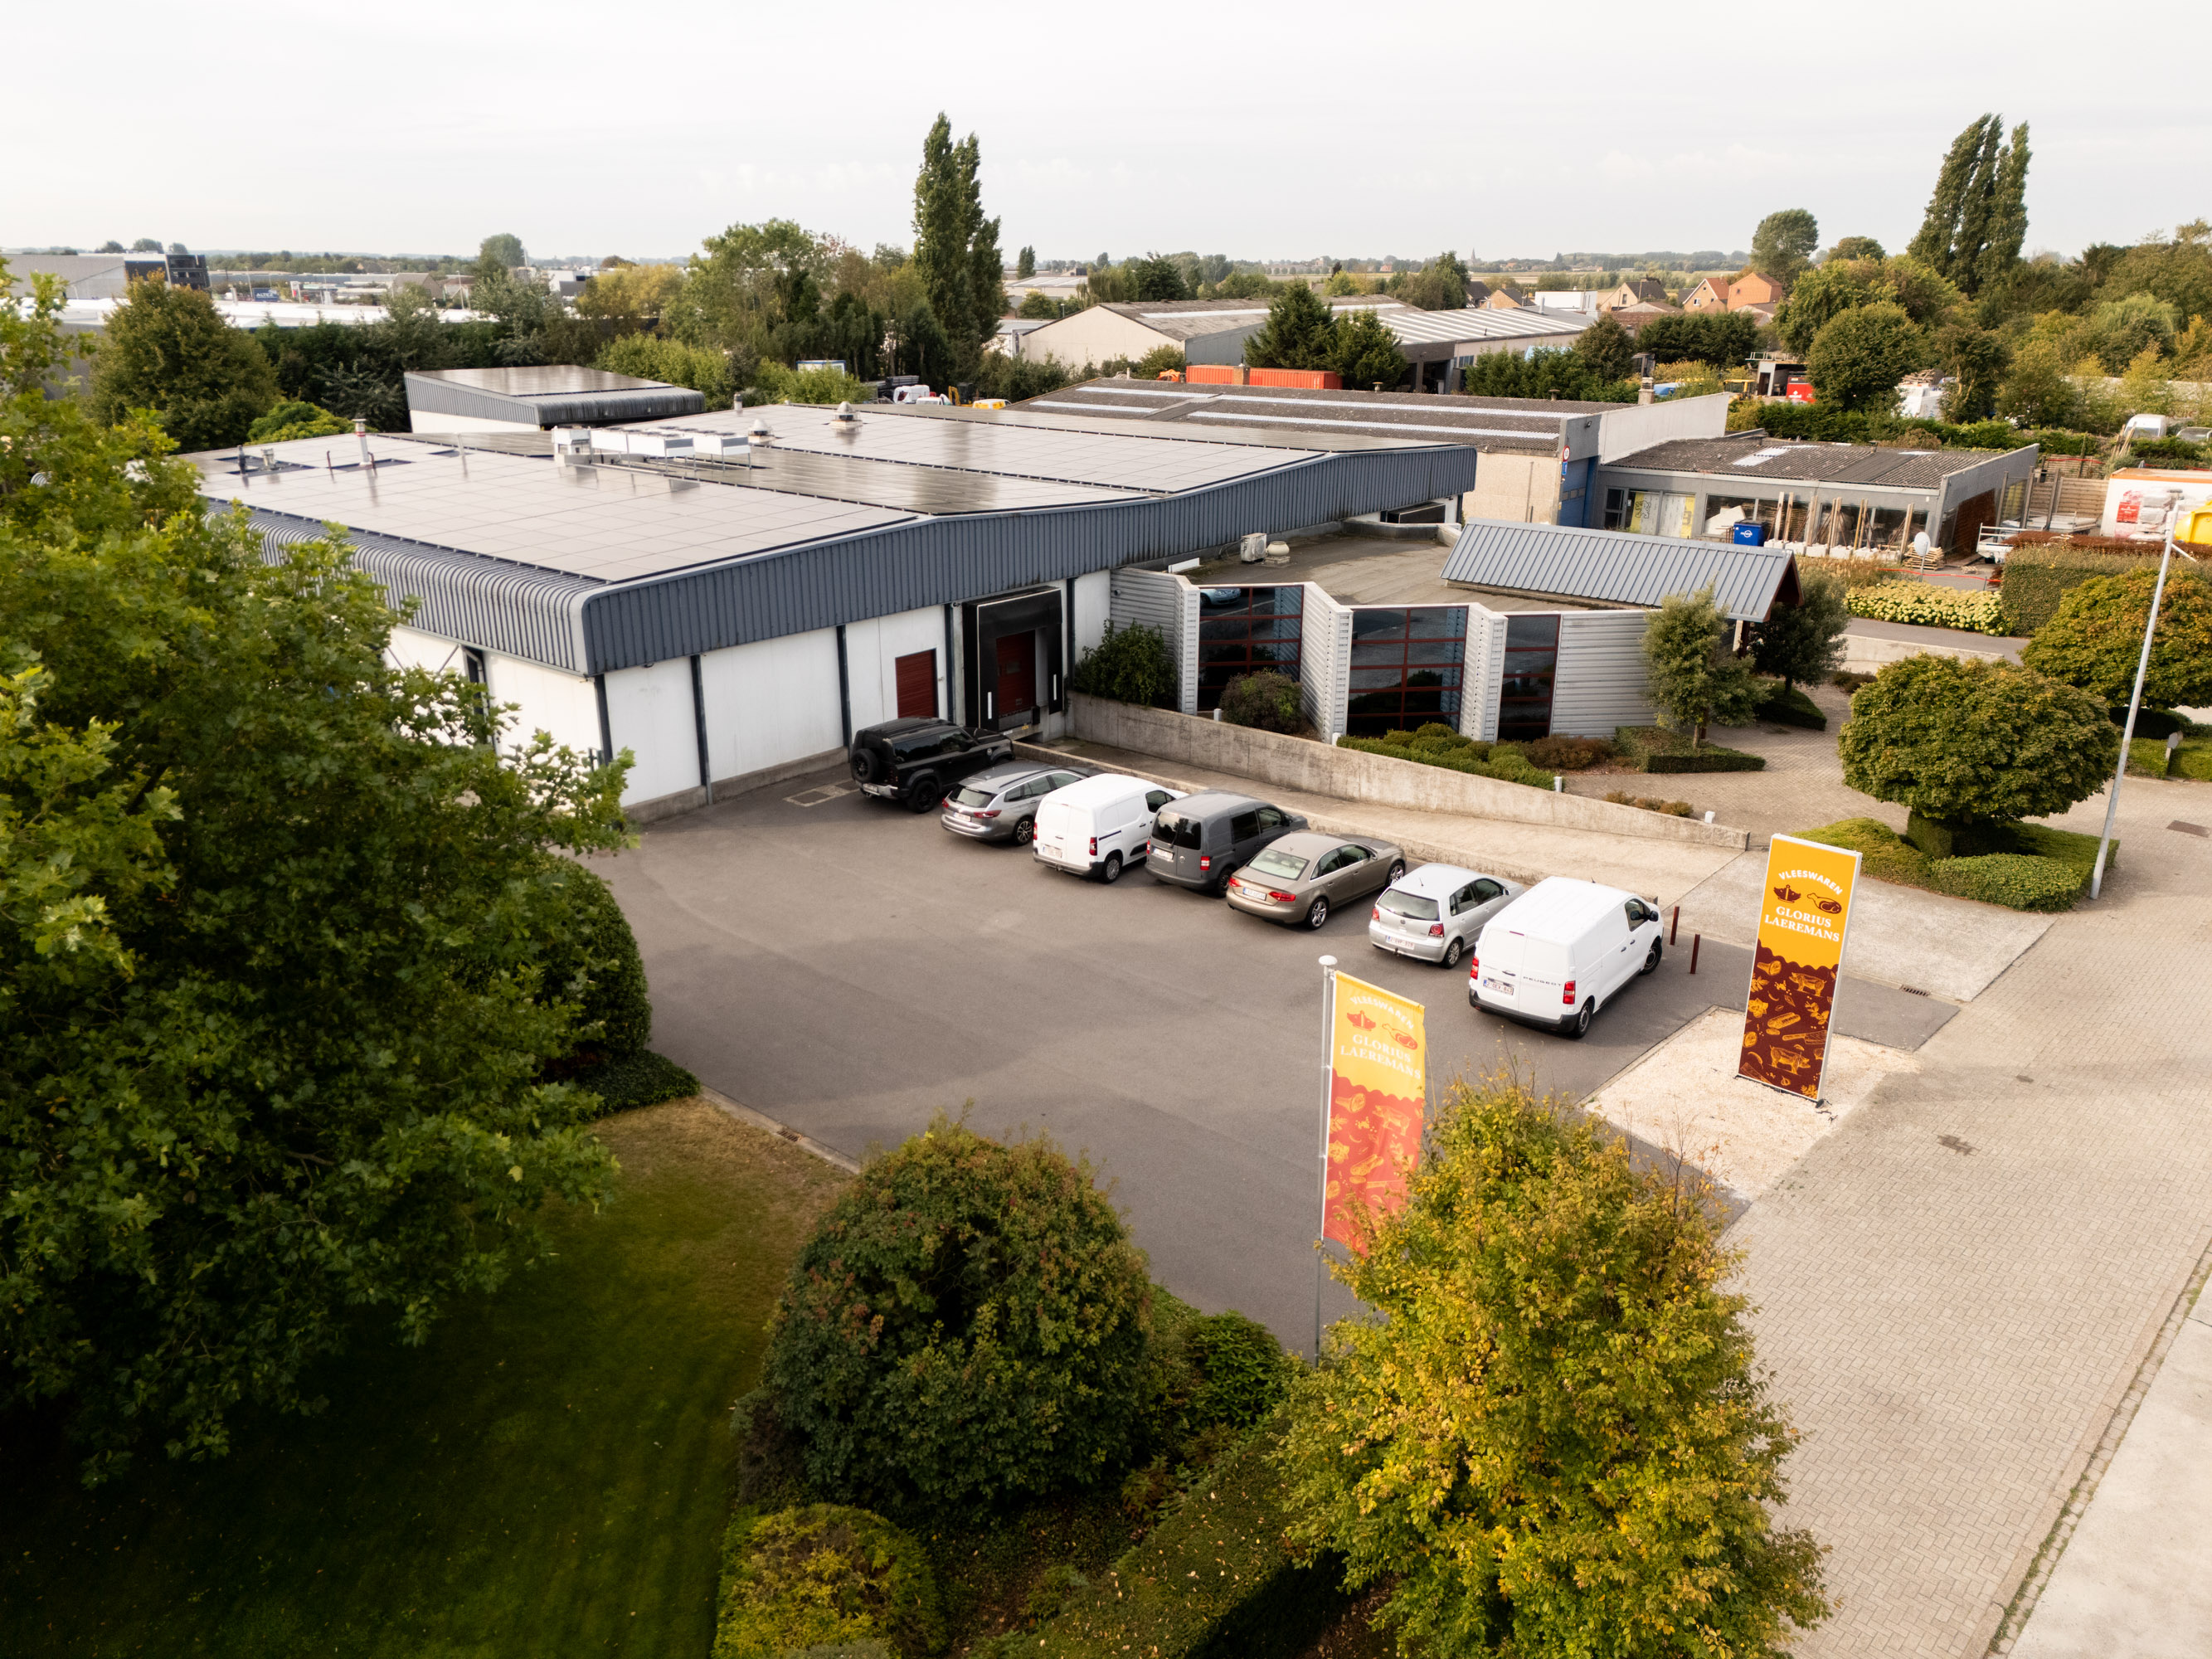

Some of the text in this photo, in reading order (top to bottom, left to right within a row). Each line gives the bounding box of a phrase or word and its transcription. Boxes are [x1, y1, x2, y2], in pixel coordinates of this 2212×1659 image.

[1778, 869, 1843, 895] VLEESWAREN
[1764, 914, 1840, 942] LAEREMANS
[1776, 906, 1832, 928] GLORIUS
[1349, 995, 1414, 1029] VLEESWAREN
[1340, 1045, 1421, 1079] LAEREMANS
[1353, 1034, 1412, 1063] GLORIUS
